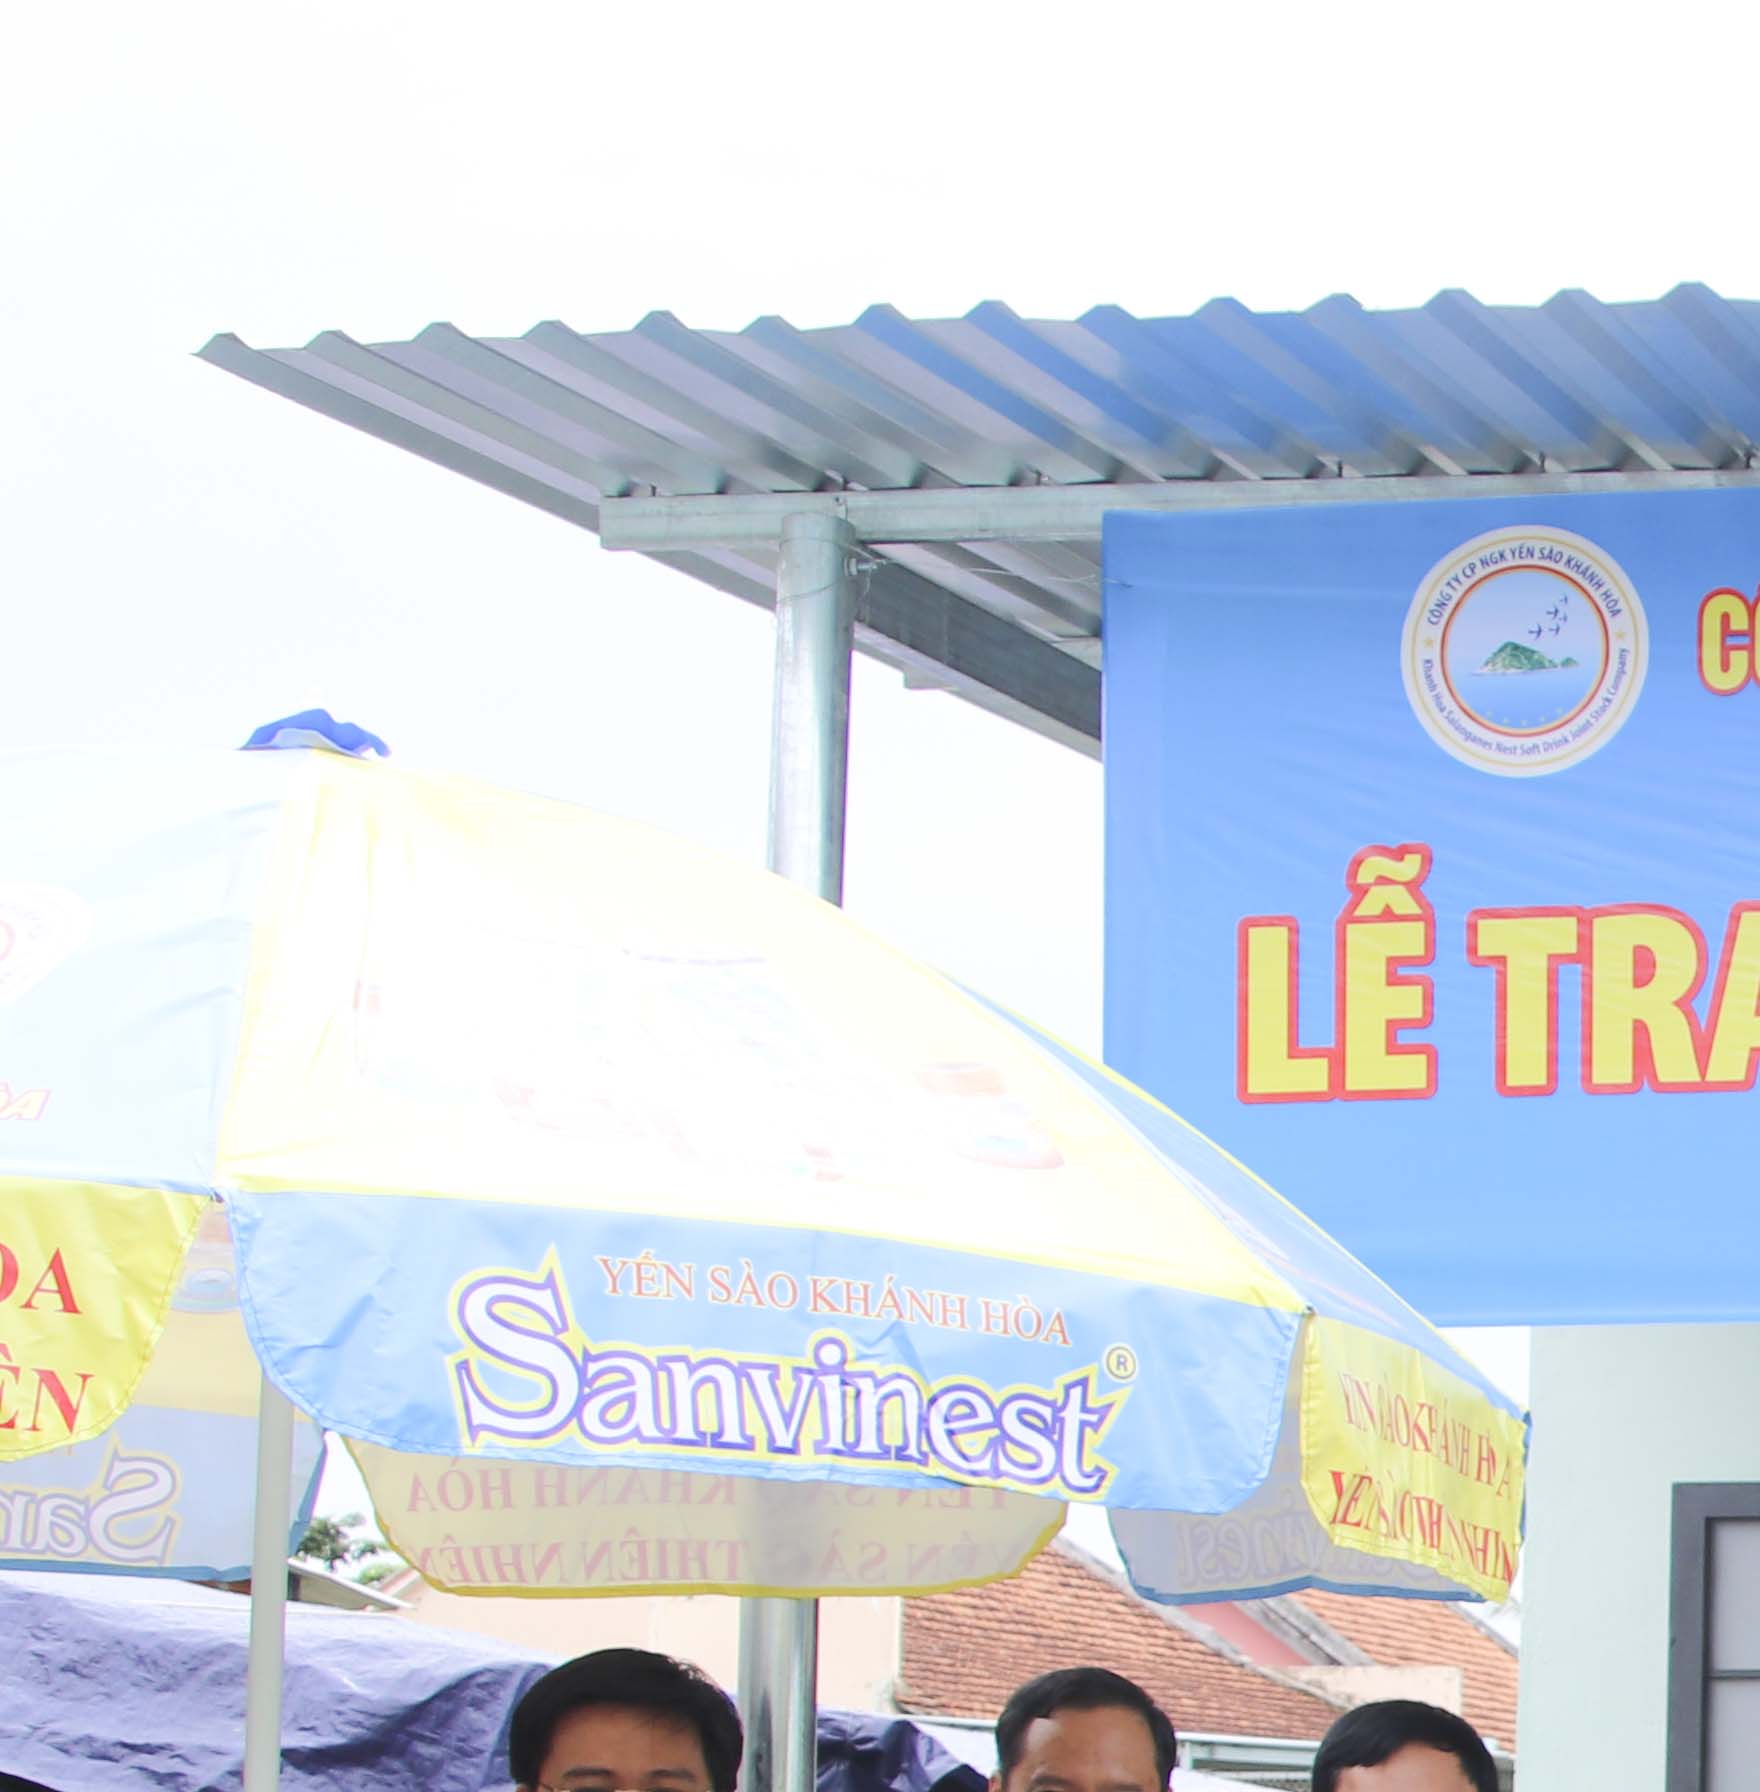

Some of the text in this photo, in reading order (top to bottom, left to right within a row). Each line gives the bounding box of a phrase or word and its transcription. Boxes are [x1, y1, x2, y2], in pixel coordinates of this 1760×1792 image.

[1237, 843, 1438, 1103] LỄ
[448, 1246, 1130, 1498] Sanvinest
[595, 1248, 1073, 1348] YẾN SÀO KHÁNH HÒA
